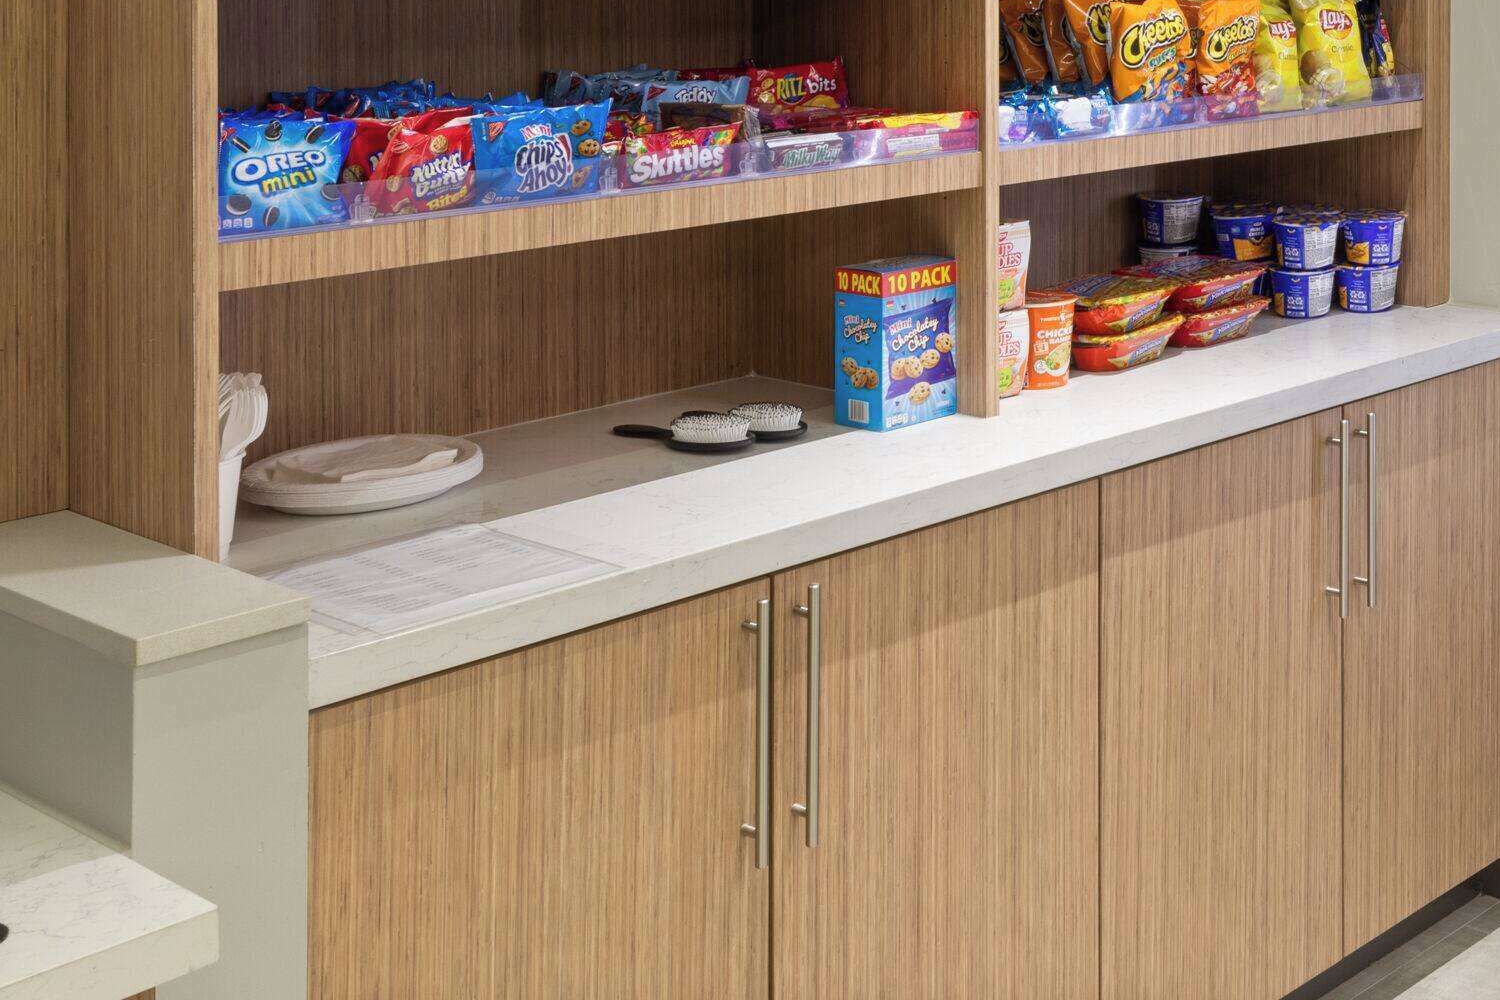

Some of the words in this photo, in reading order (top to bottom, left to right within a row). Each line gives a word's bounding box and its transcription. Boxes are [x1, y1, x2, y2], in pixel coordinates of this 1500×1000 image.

[1321, 9, 1351, 31] Lay's
[1121, 12, 1187, 68] Cheetos
[1207, 16, 1258, 61] Cheetos
[675, 86, 717, 104] Teddy
[776, 75, 807, 99] RITZ
[806, 78, 837, 94] bits
[234, 150, 326, 183] OREO
[516, 137, 565, 175] Chips
[631, 145, 725, 184] Skittles
[783, 146, 815, 168] Milky
[815, 143, 843, 166] Way
[261, 167, 315, 194] mini
[837, 272, 849, 290] 10
[852, 273, 880, 294] PACK
[888, 274, 907, 293] 10
[911, 265, 951, 290] PACK
[892, 317, 939, 351] Chocolatey
[908, 334, 930, 352] Chip
